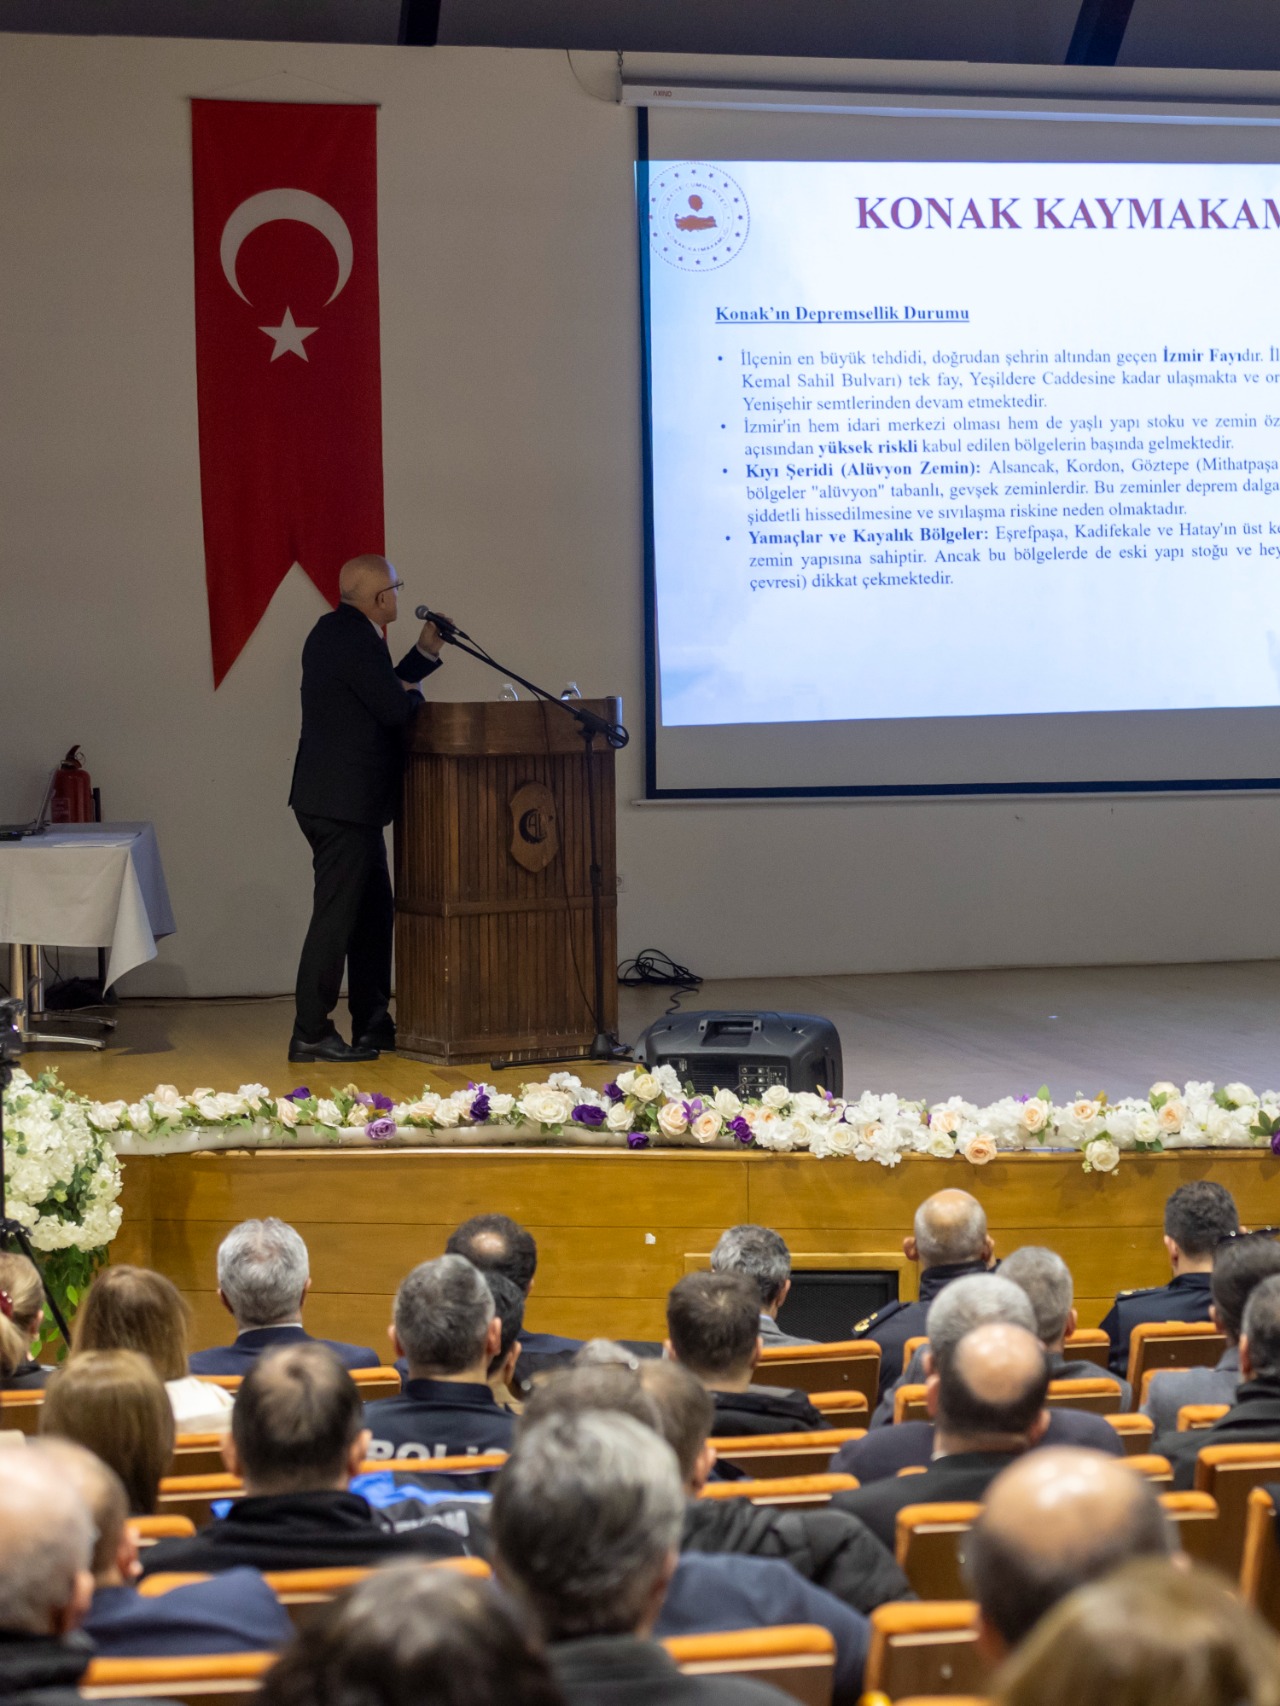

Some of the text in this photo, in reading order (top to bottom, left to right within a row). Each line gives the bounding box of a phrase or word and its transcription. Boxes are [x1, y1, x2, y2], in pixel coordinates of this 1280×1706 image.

[855, 196, 1022, 229] KONAK
[795, 305, 899, 322] Depremsellik
[904, 305, 970, 320] Durumu
[740, 347, 792, 370] İlçenin
[797, 354, 815, 366] en
[819, 349, 867, 369] büyük
[871, 349, 927, 366] tehdidi,
[931, 349, 1000, 369] doğrudan
[1005, 348, 1049, 368] şehrin
[1054, 348, 1111, 364] altından
[1116, 352, 1158, 367] geçen
[1162, 345, 1205, 363] İzmir
[1208, 347, 1264, 367] Fayıdır.
[741, 373, 791, 389] Kemal
[797, 372, 835, 389] Sahil
[841, 371, 903, 389] Bulvarı)
[908, 371, 931, 387] tek
[937, 371, 963, 391] fay,
[969, 371, 1036, 390] Yeşildere
[1041, 370, 1116, 385] Caddesine
[1121, 370, 1161, 385] kadar
[1166, 368, 1238, 388] ulaşmakta
[1243, 372, 1260, 384] ve
[742, 393, 1047, 415] Yenişehir semtlerinden devam etmektedir.
[744, 415, 801, 434] İzmir'in
[808, 417, 840, 433] hem
[847, 417, 881, 433] idari
[887, 415, 946, 433] merkezi
[952, 416, 1001, 431] olması
[1007, 415, 1039, 431] hem
[1045, 414, 1063, 430] de
[1069, 414, 1103, 433] yaşlı
[1109, 418, 1140, 433] yapı
[1146, 412, 1185, 429] stoku
[1191, 417, 1209, 428] ve
[1215, 413, 1257, 428] zemin
[744, 434, 1234, 460] açısından yüksek riskli kabul edilen bölgelerin başında gelmektedir.
[745, 462, 780, 482] Kıyı
[785, 462, 834, 481] Şeridi
[840, 461, 913, 480] (Alüvyon
[919, 459, 981, 478] Zemin):
[988, 458, 1059, 476] Alsancak,
[1066, 458, 1125, 475] Kordon,
[1131, 457, 1190, 476] Göztepe
[1195, 455, 1279, 476] (Mithatpaşa
[746, 484, 807, 505] bölgeler
[811, 483, 885, 503] "alüvyon"
[890, 482, 944, 499] tabanlı,
[949, 481, 999, 501] gevşek
[1004, 480, 1089, 497] zeminlerdir.
[1094, 478, 1115, 495] Bu
[1119, 478, 1182, 494] zeminler
[1185, 477, 1238, 498] deprem
[747, 499, 1187, 527] şiddetli hissedilmesine ve sıvılaşma riskine neden olmaktadır.
[748, 529, 824, 549] Yamaçlar
[828, 532, 847, 543] ve
[852, 526, 915, 547] Kayalık
[919, 525, 989, 545] Bölgeler:
[995, 523, 1069, 544] Eşrefpaşa,
[1074, 522, 1152, 539] Kadifekale
[1156, 526, 1174, 537] ve
[1179, 521, 1237, 541] Hatay'ın
[1242, 522, 1263, 536] üst
[749, 551, 794, 568] zemin
[800, 554, 863, 570] yapısına
[869, 548, 927, 569] sahiptir.
[934, 547, 982, 564] Ancak
[988, 547, 1007, 562] bu
[1013, 544, 1089, 566] bölgelerde
[1094, 544, 1112, 560] de
[1118, 543, 1148, 560] eski
[1154, 547, 1185, 562] yapı
[1191, 543, 1229, 562] stoğu
[1235, 546, 1252, 557] ve
[749, 570, 954, 592] çevresi) dikkat çekmektedir.
